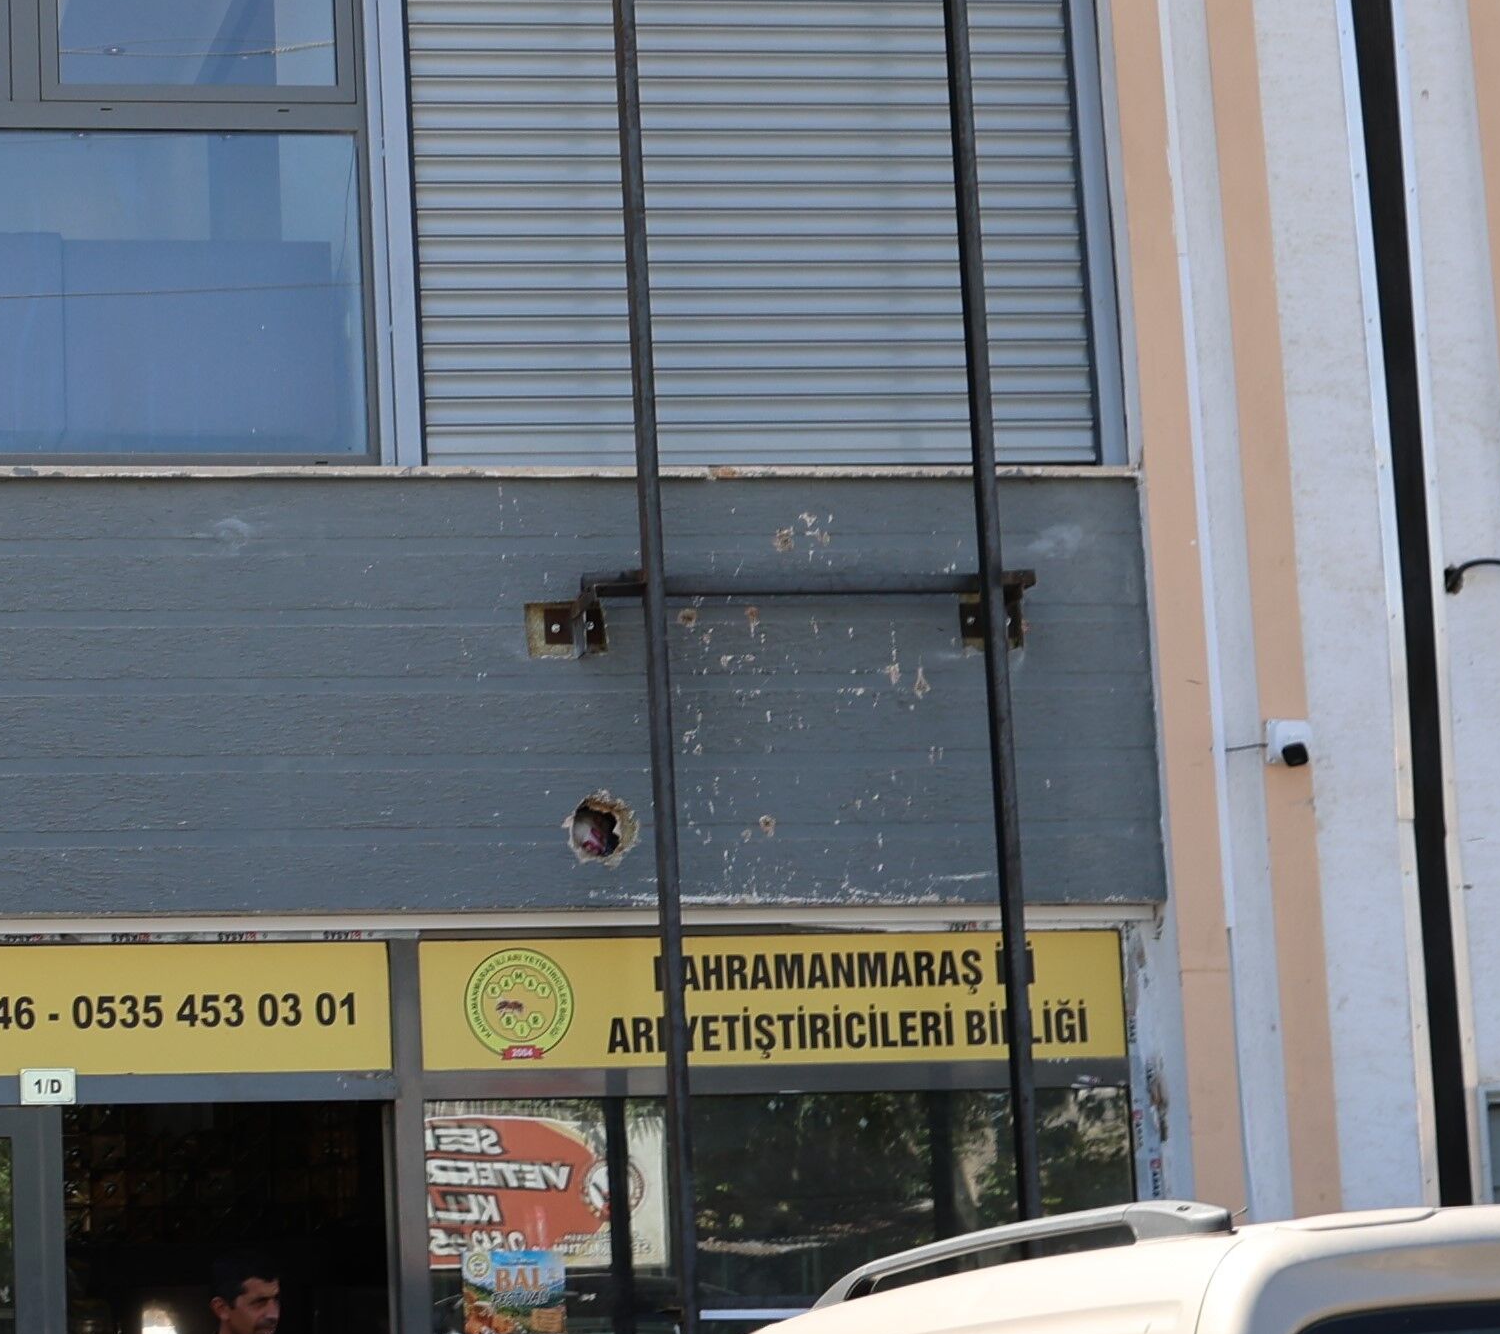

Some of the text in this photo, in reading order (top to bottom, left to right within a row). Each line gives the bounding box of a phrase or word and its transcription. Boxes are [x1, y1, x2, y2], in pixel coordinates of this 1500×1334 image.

[71, 994, 165, 1030] 0535
[175, 992, 246, 1028] 453
[256, 992, 303, 1027] 03
[314, 991, 358, 1026] 01
[33, 1078, 62, 1095] 1/D
